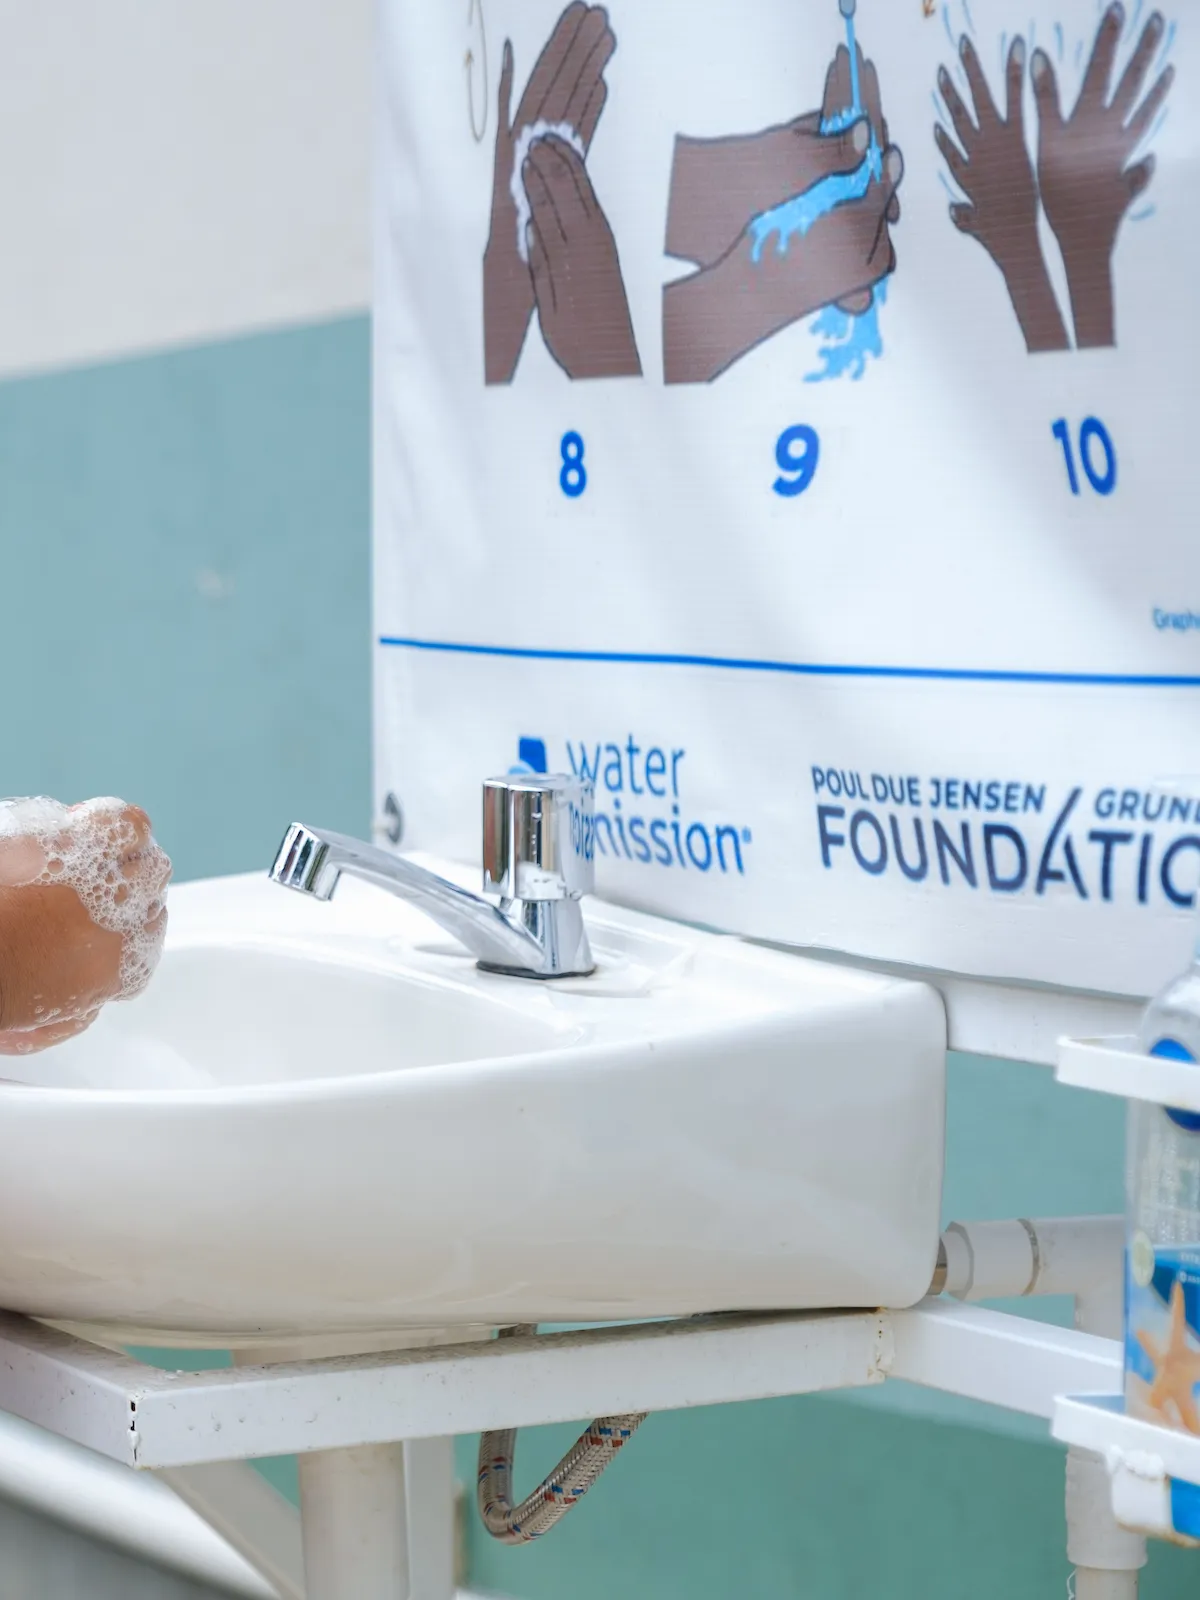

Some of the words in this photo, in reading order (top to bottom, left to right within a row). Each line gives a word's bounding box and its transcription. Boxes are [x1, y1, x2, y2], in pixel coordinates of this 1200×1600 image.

[559, 430, 587, 498] 8
[771, 423, 820, 498] 9
[1051, 415, 1117, 496] 10
[566, 733, 685, 797] water
[811, 765, 869, 801] POUL
[871, 774, 922, 807] DUE
[929, 777, 1047, 813] JENSEN
